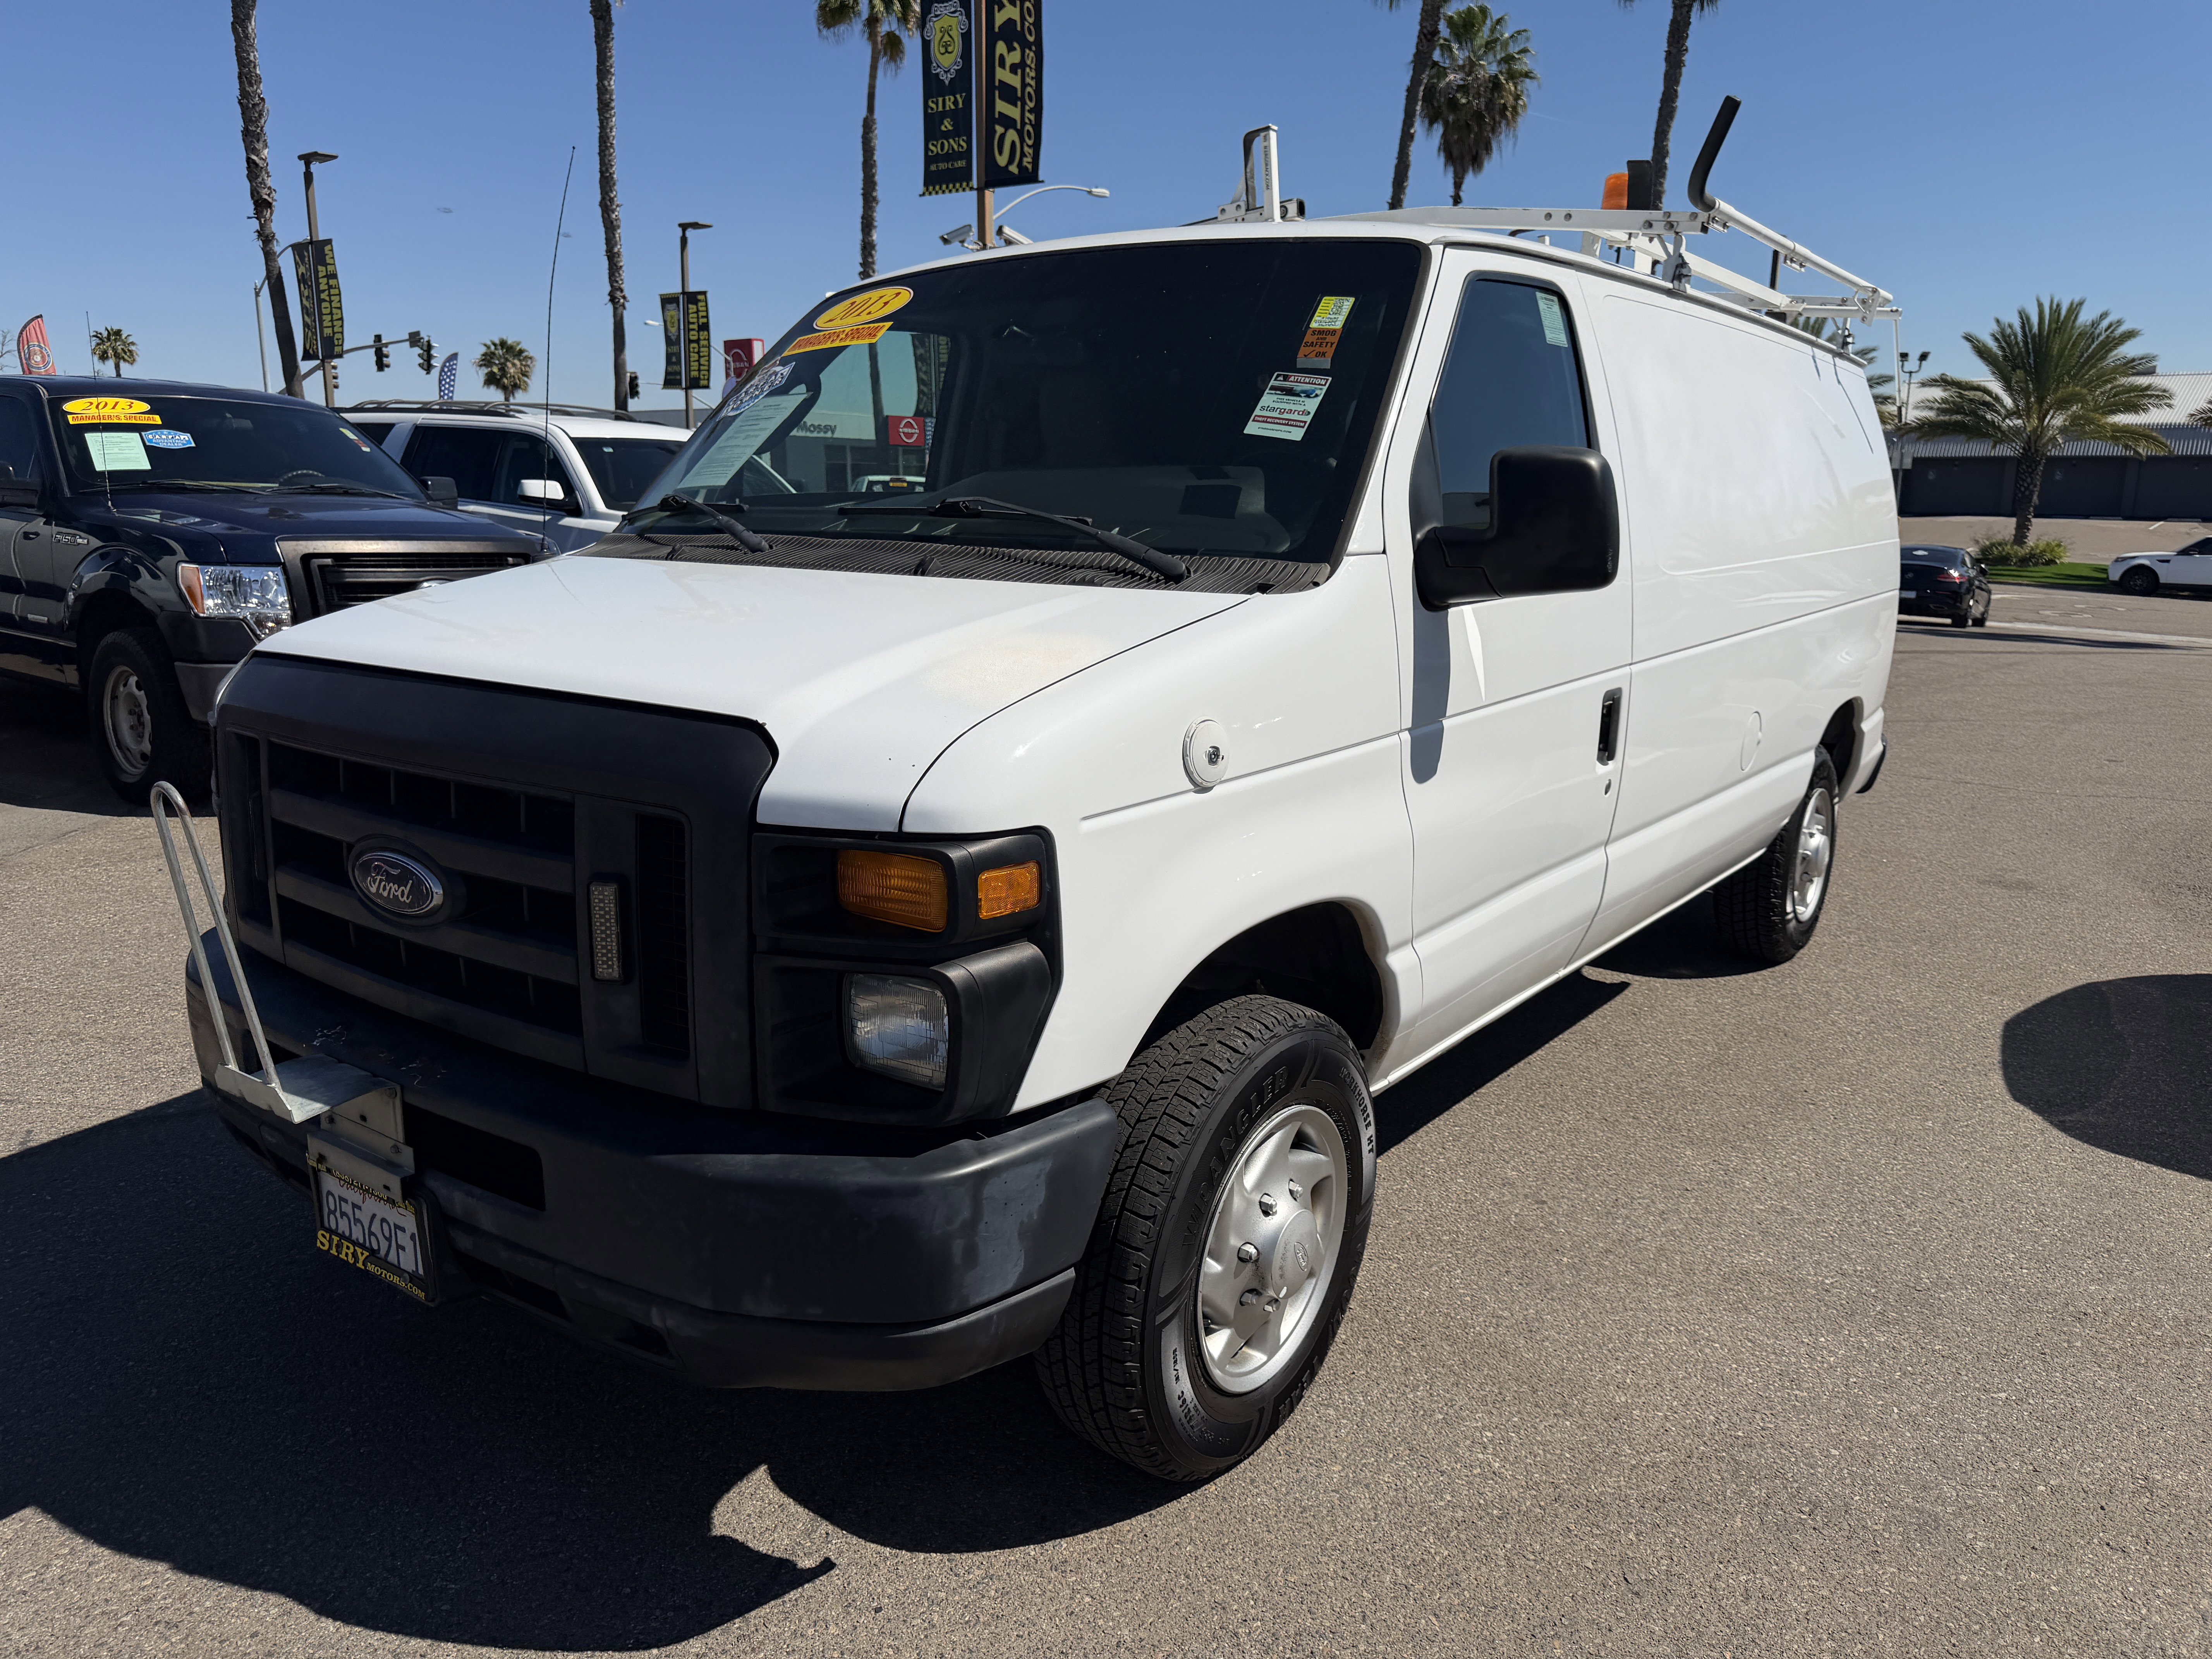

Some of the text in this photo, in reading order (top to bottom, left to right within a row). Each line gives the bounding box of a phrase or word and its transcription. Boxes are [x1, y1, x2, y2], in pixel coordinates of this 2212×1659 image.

[927, 93, 967, 113] SIRY
[994, 0, 1021, 175] SIRY
[1022, 0, 1036, 173] MOTORS.CO
[928, 136, 967, 155] SONS
[941, 118, 953, 131] &
[318, 265, 333, 337] ANYONE
[324, 244, 343, 355] WE FINANCE
[823, 292, 902, 324] 2013
[839, 325, 886, 343] SPECIAL
[688, 304, 699, 378] AUTO CARE
[697, 295, 709, 386] FULL SERVICE
[81, 401, 134, 410] 2013
[1288, 375, 1326, 385] ATTENTION
[368, 862, 412, 903] Ford
[1339, 1067, 1374, 1154] WORKHORSE HT
[1182, 1065, 1288, 1250] WRANGLER
[316, 1230, 426, 1301] SIRY MOTORS.COM
[325, 1190, 423, 1276] 85569F1
